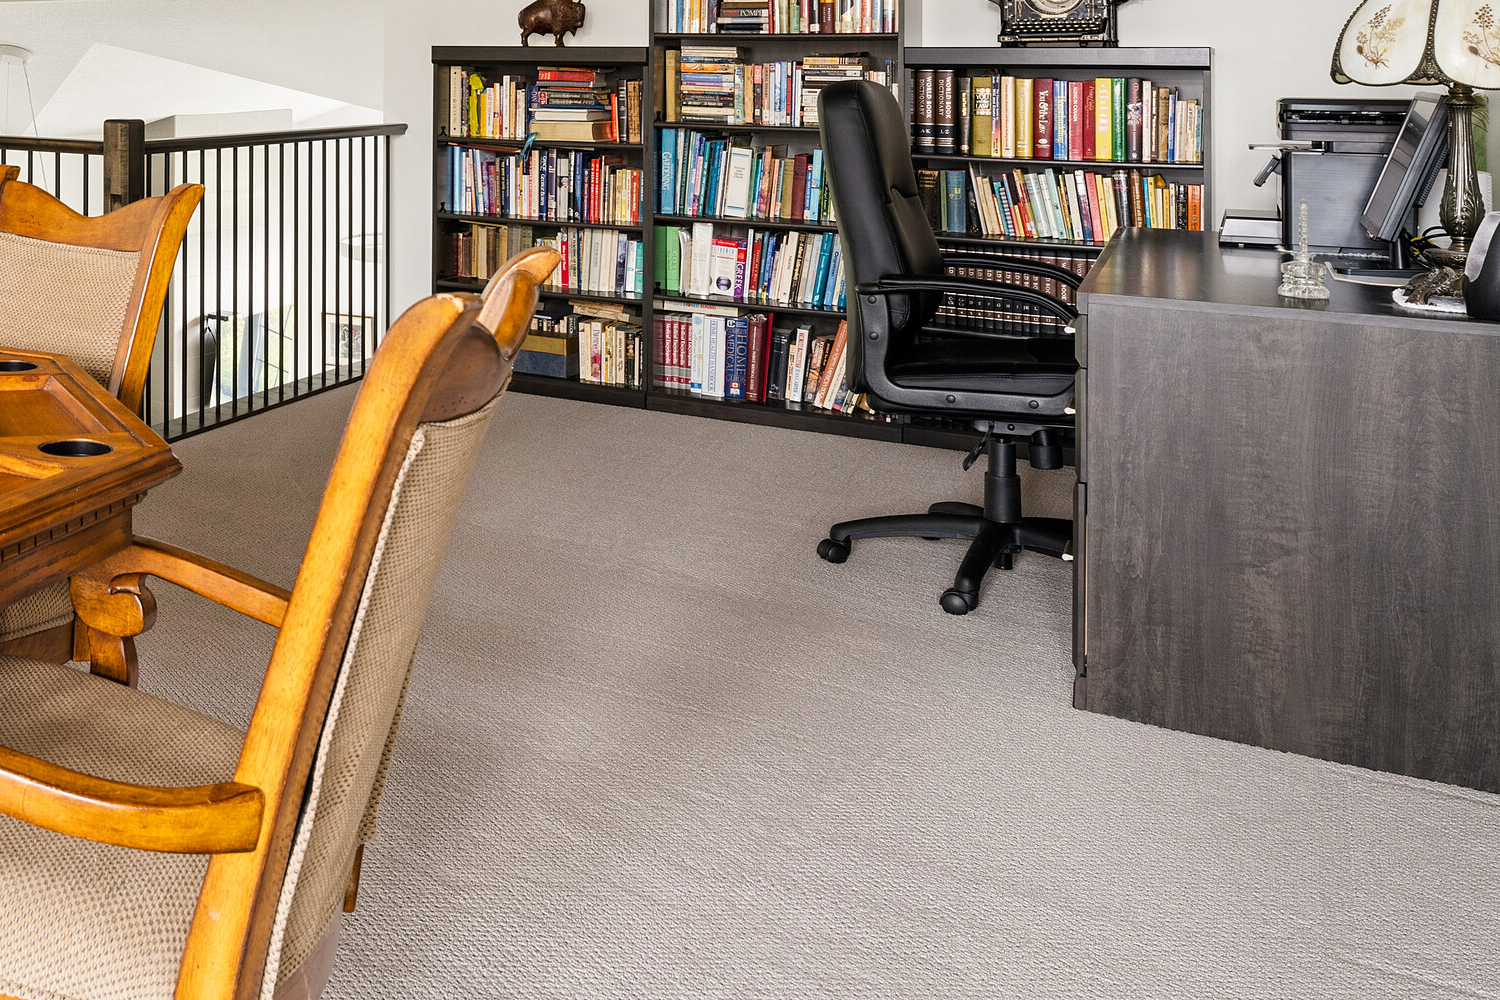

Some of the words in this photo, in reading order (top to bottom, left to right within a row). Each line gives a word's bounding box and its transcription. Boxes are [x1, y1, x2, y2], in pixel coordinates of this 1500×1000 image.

[662, 152, 672, 191] GARDENING
[734, 263, 744, 290] GREEK
[830, 251, 840, 278] Cognition
[726, 334, 736, 373] MEDICAL
[736, 334, 747, 376] HOME
